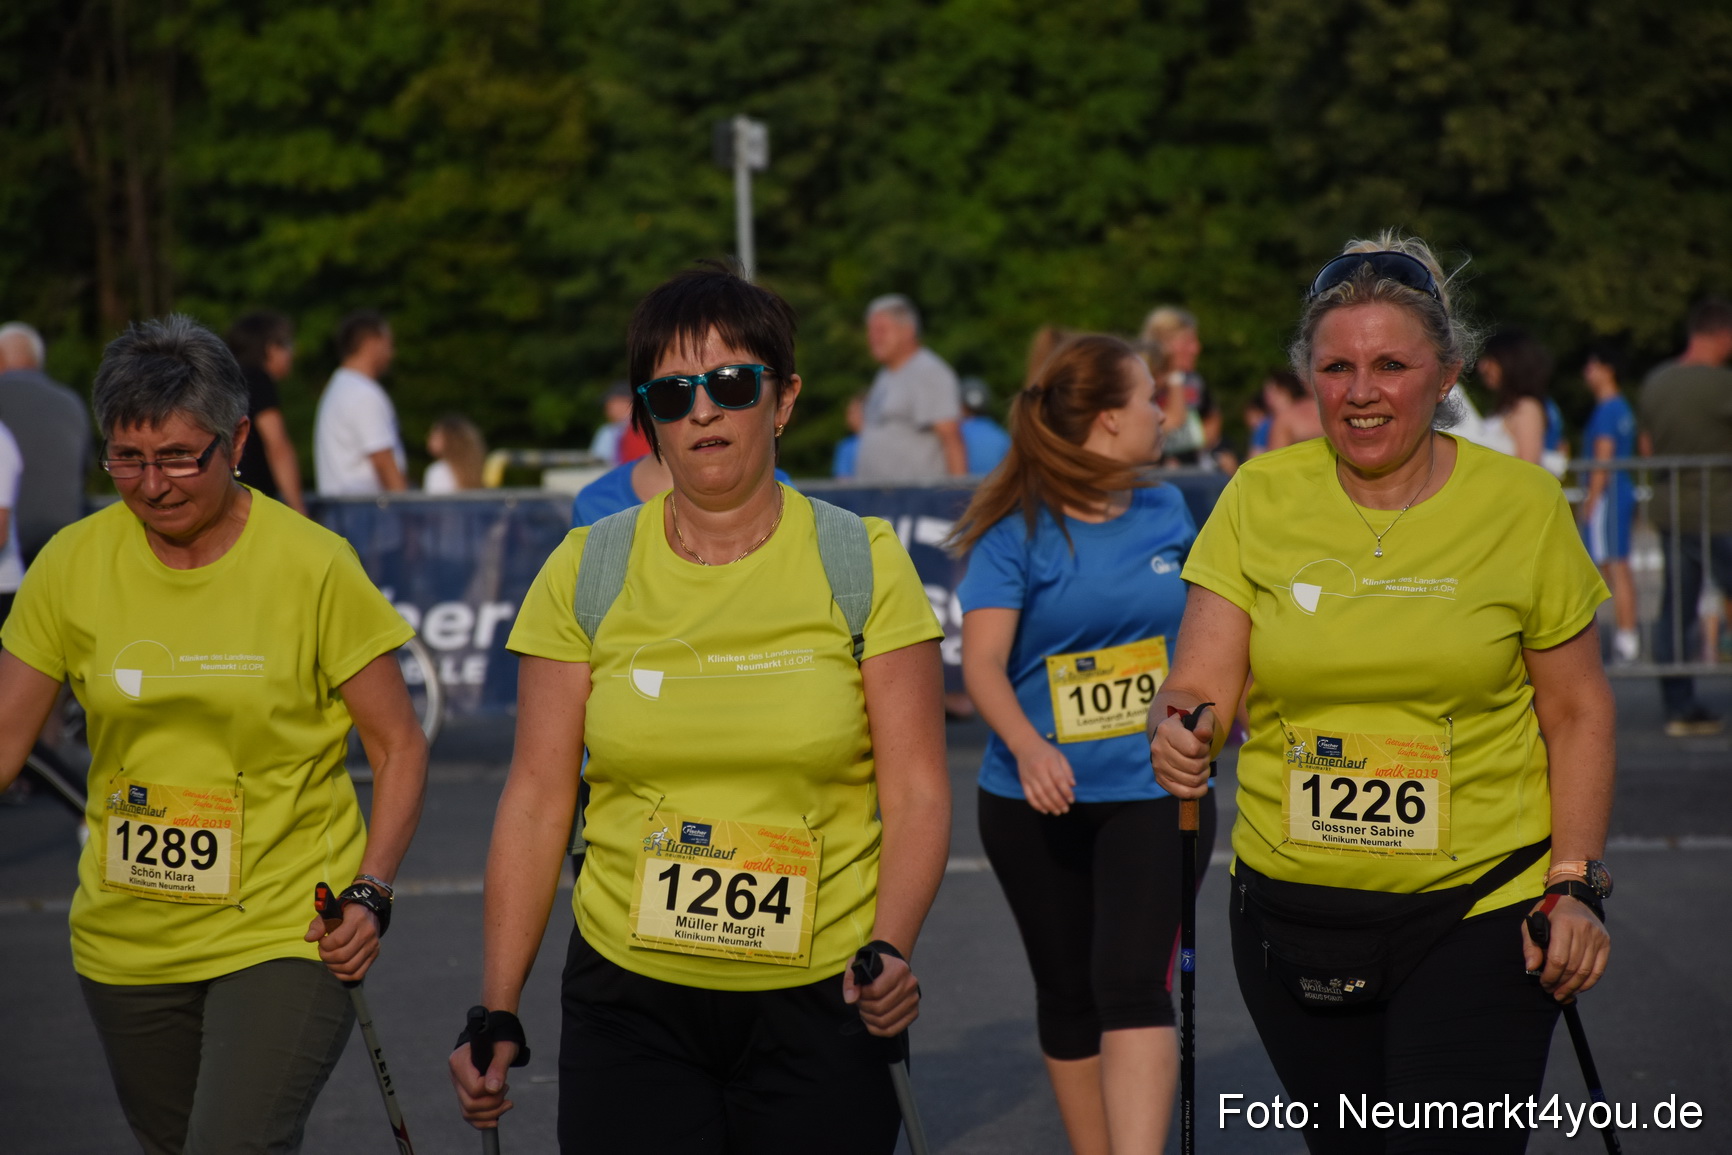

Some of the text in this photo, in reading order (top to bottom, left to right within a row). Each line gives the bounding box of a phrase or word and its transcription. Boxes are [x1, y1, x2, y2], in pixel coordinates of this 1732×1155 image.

[1362, 577, 1395, 586] Kliniken
[1414, 576, 1459, 585] Landkreises
[1385, 585, 1427, 593] Neumarkt
[179, 653, 265, 662] Kliniken des Landkreises
[707, 648, 814, 663] Kliniken des Landkreises
[200, 663, 237, 671] Neumarkt
[736, 660, 781, 672] Neumarkt
[1069, 674, 1156, 716] 1079
[1305, 752, 1368, 770] firmenlauf
[1375, 764, 1438, 778] walk 2019
[1302, 774, 1426, 825] 1226
[120, 800, 168, 818] firmenlauf
[173, 814, 232, 829] walk 2019
[1311, 820, 1415, 838] Glossner Sabine
[116, 820, 218, 871] 1289
[1322, 834, 1402, 848] Klinikum Neumarkt
[667, 839, 738, 861] firmenlauf
[131, 865, 195, 882] Schön Klara
[743, 857, 808, 877] walk 2019
[129, 876, 157, 888] Klinikum
[158, 881, 196, 892] Neumarkt
[658, 863, 792, 925] 1264
[675, 915, 766, 940] Müller Margit
[674, 929, 716, 943] Klinikum
[717, 935, 763, 949] Neumarkt
